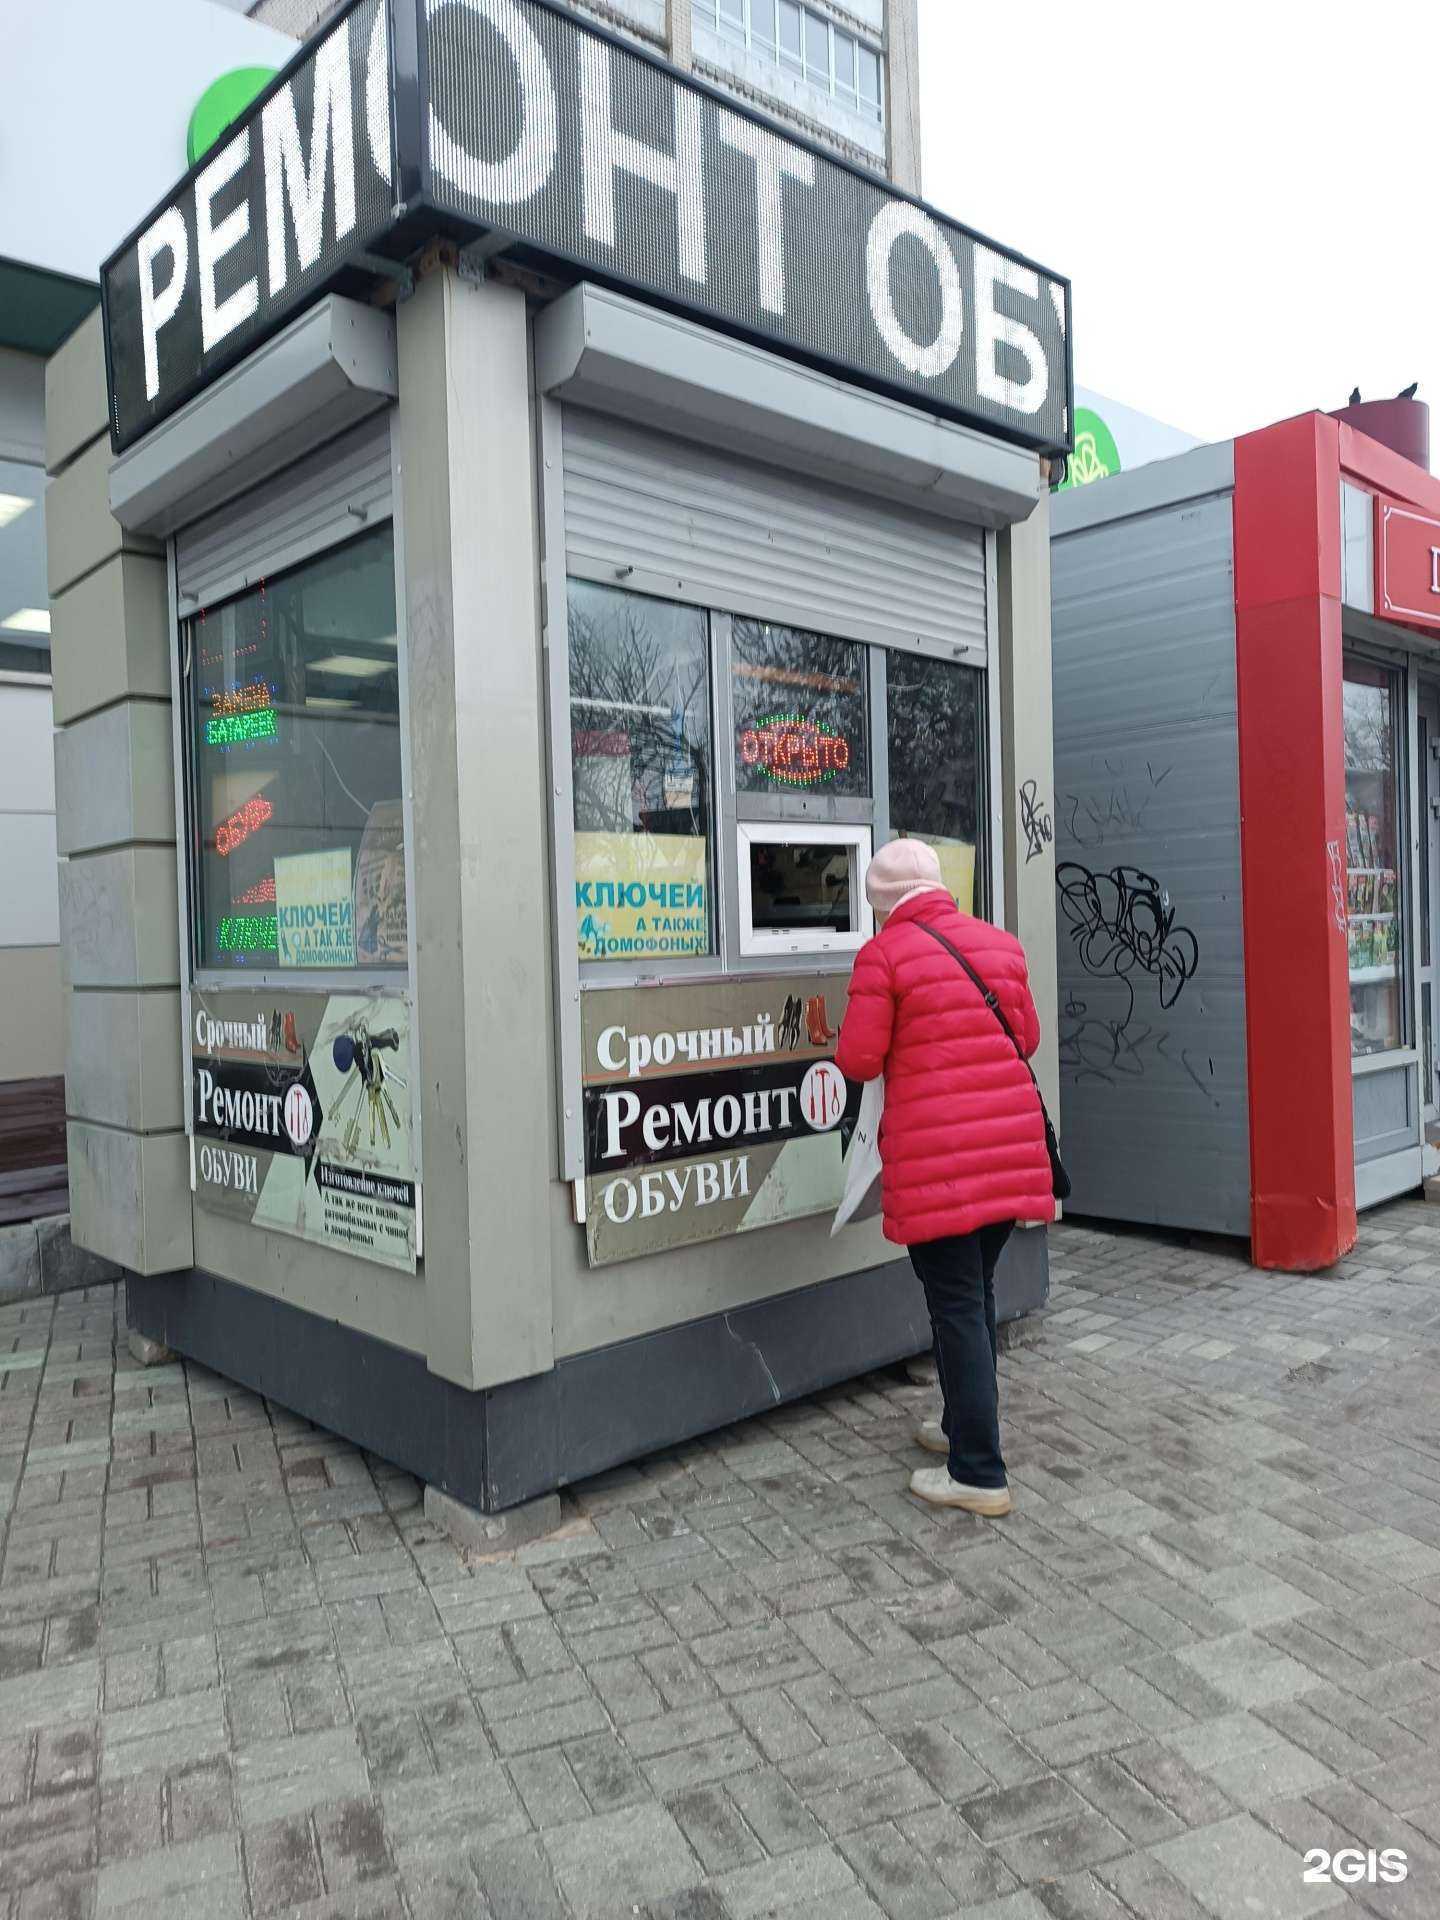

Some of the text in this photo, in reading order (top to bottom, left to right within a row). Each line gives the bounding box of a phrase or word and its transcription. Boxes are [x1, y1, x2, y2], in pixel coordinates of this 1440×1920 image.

[866, 200, 1067, 433] ОБ
[207, 709, 276, 744] БАТАРЕЕК
[743, 730, 848, 768] ОТКРЫТО
[279, 897, 352, 929] КЛЮЧЕЙ
[575, 878, 703, 908] КЛЮЧЕЙ
[219, 916, 277, 949] КЛЮЧЕ
[304, 929, 311, 947] А
[636, 916, 647, 932] А
[195, 1010, 267, 1054] Срочный
[596, 1013, 775, 1078] Срочный
[199, 1069, 284, 1136] Ремонт
[599, 1086, 797, 1159] Ремонт
[200, 1145, 258, 1194] ОБУВИ
[603, 1156, 751, 1224] ОБУВИ
